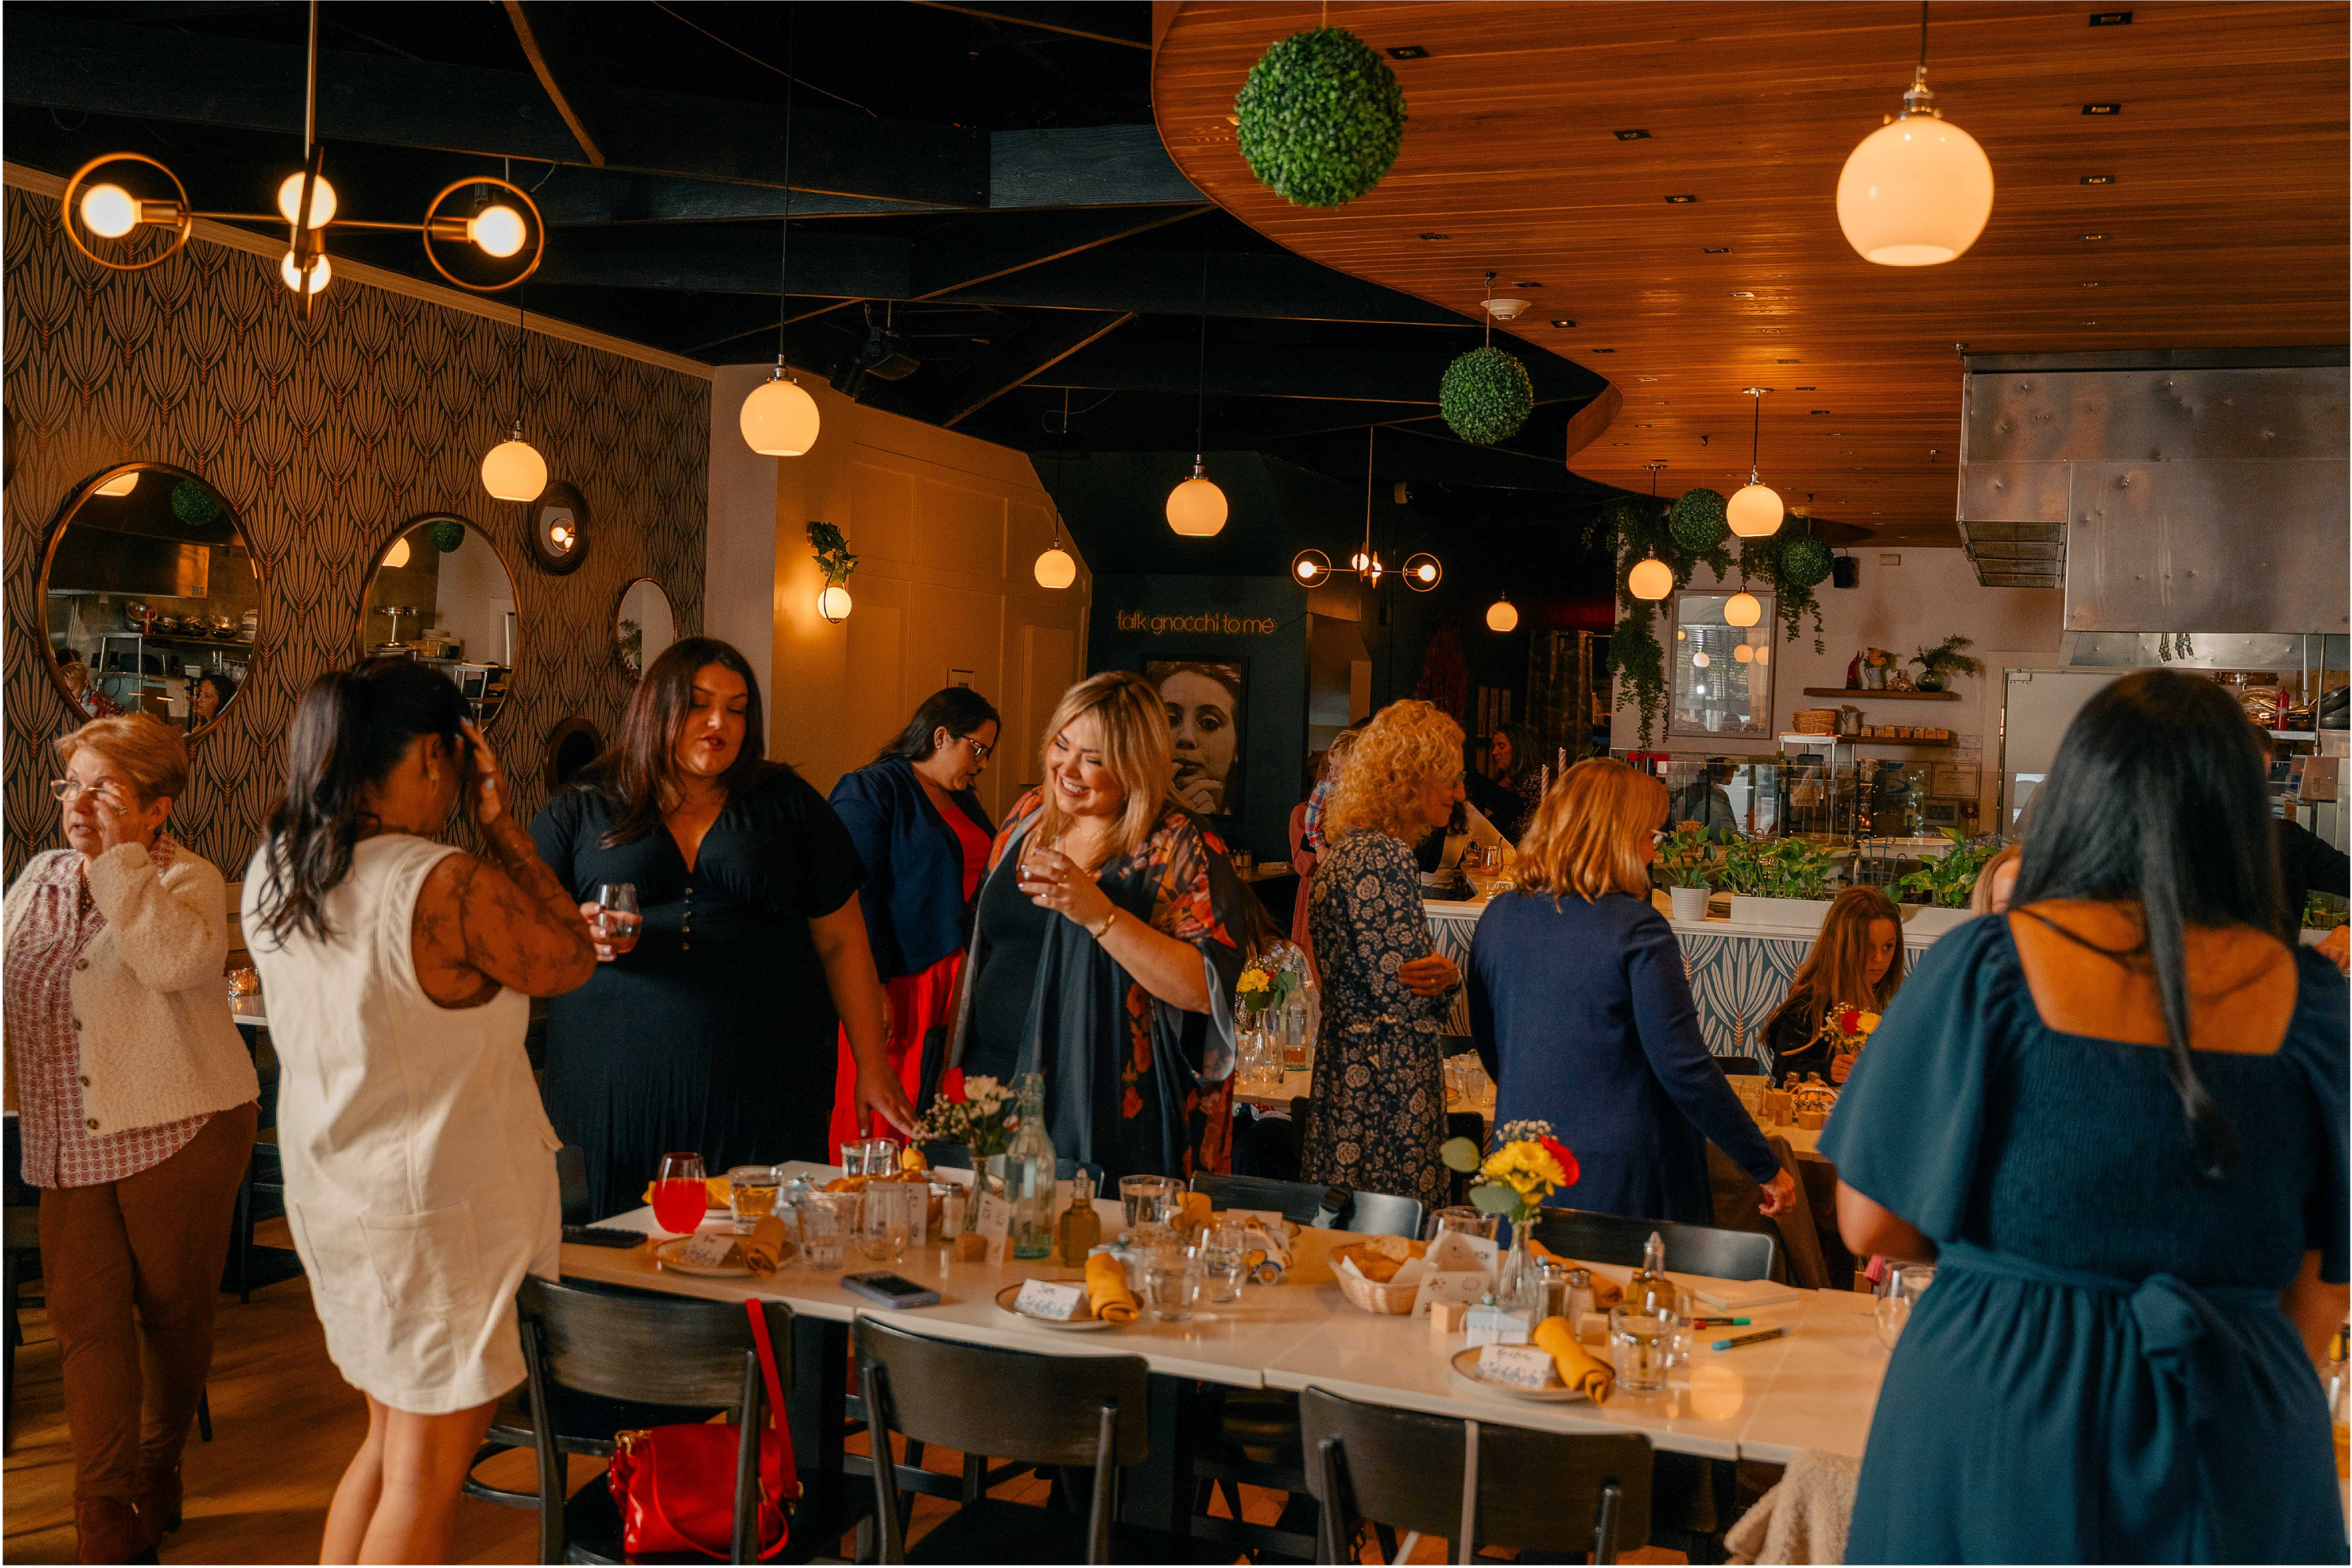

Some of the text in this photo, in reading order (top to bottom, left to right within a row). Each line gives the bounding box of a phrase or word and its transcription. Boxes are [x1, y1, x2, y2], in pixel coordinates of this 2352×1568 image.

[1117, 610, 1275, 634] talk gnocchi to me
